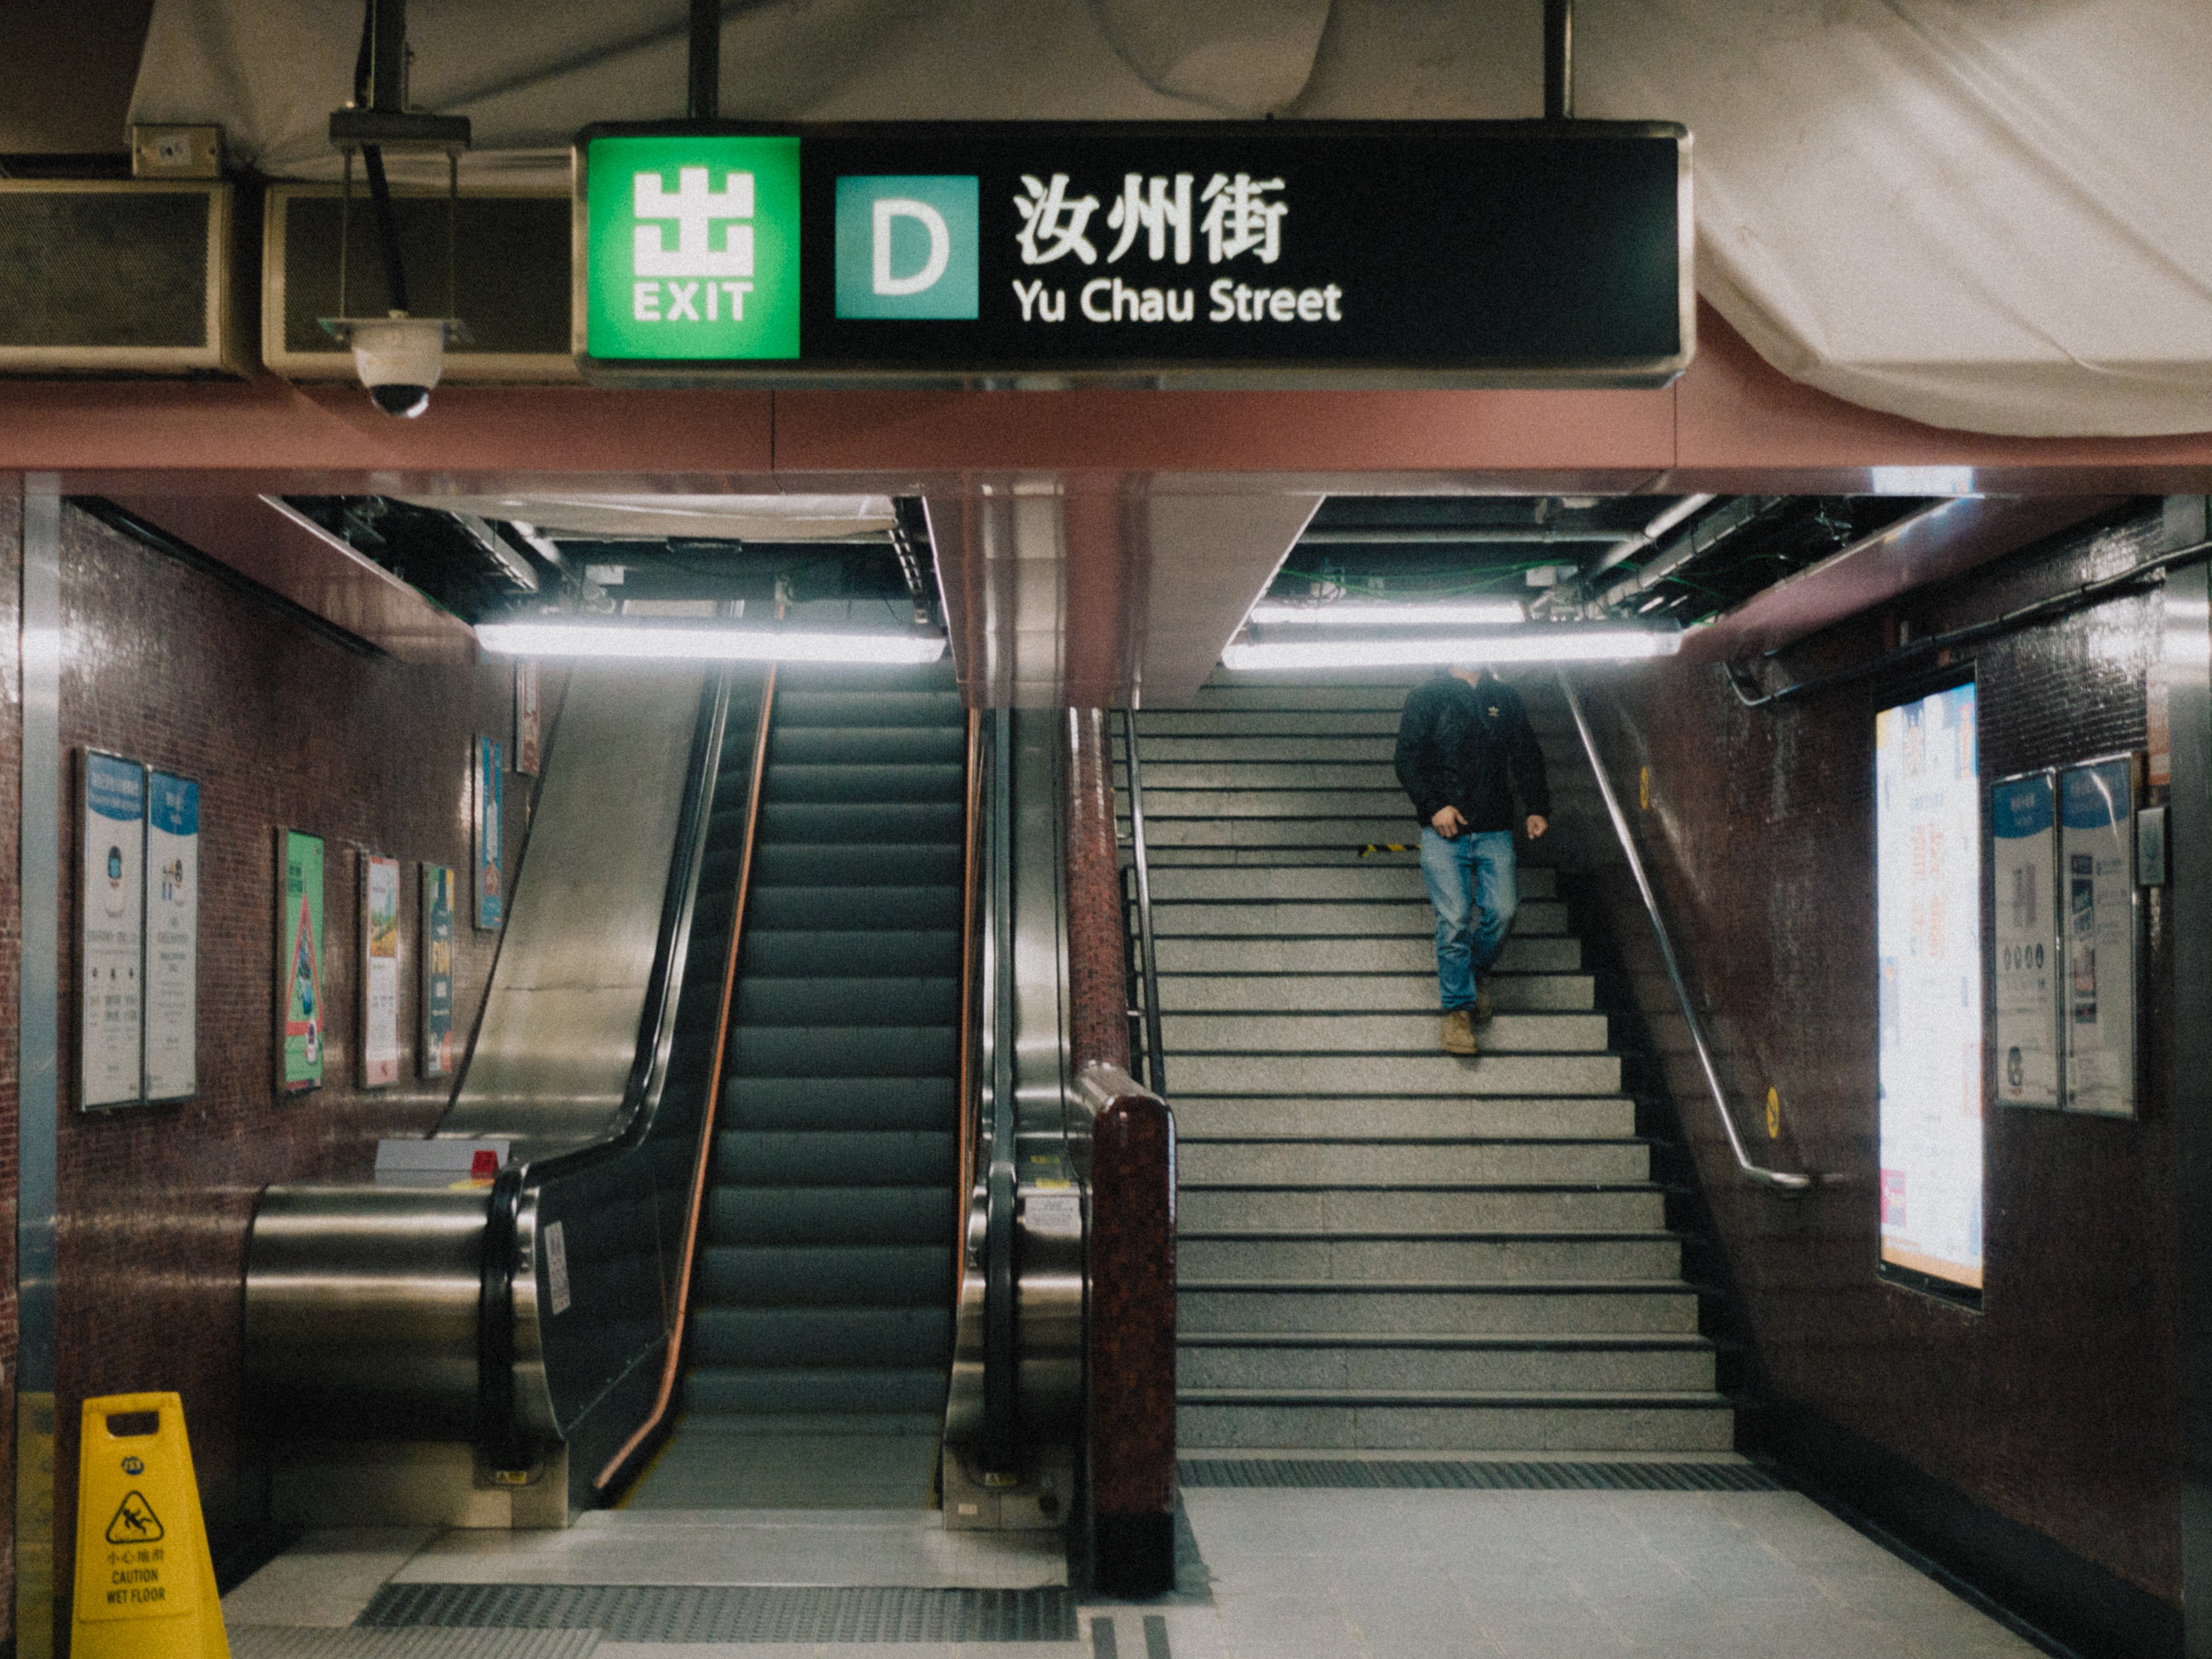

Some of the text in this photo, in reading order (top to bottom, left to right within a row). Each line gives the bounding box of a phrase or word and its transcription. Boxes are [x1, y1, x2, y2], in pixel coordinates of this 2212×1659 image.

[632, 167, 754, 277] 出
[1014, 174, 1288, 264] 汝州街
[873, 199, 950, 295] D
[633, 281, 754, 322] EXIT
[1013, 277, 1342, 322] Yu Chau Street
[107, 1587, 165, 1604] WET FLOOR
[112, 1569, 157, 1585] CAUTION
